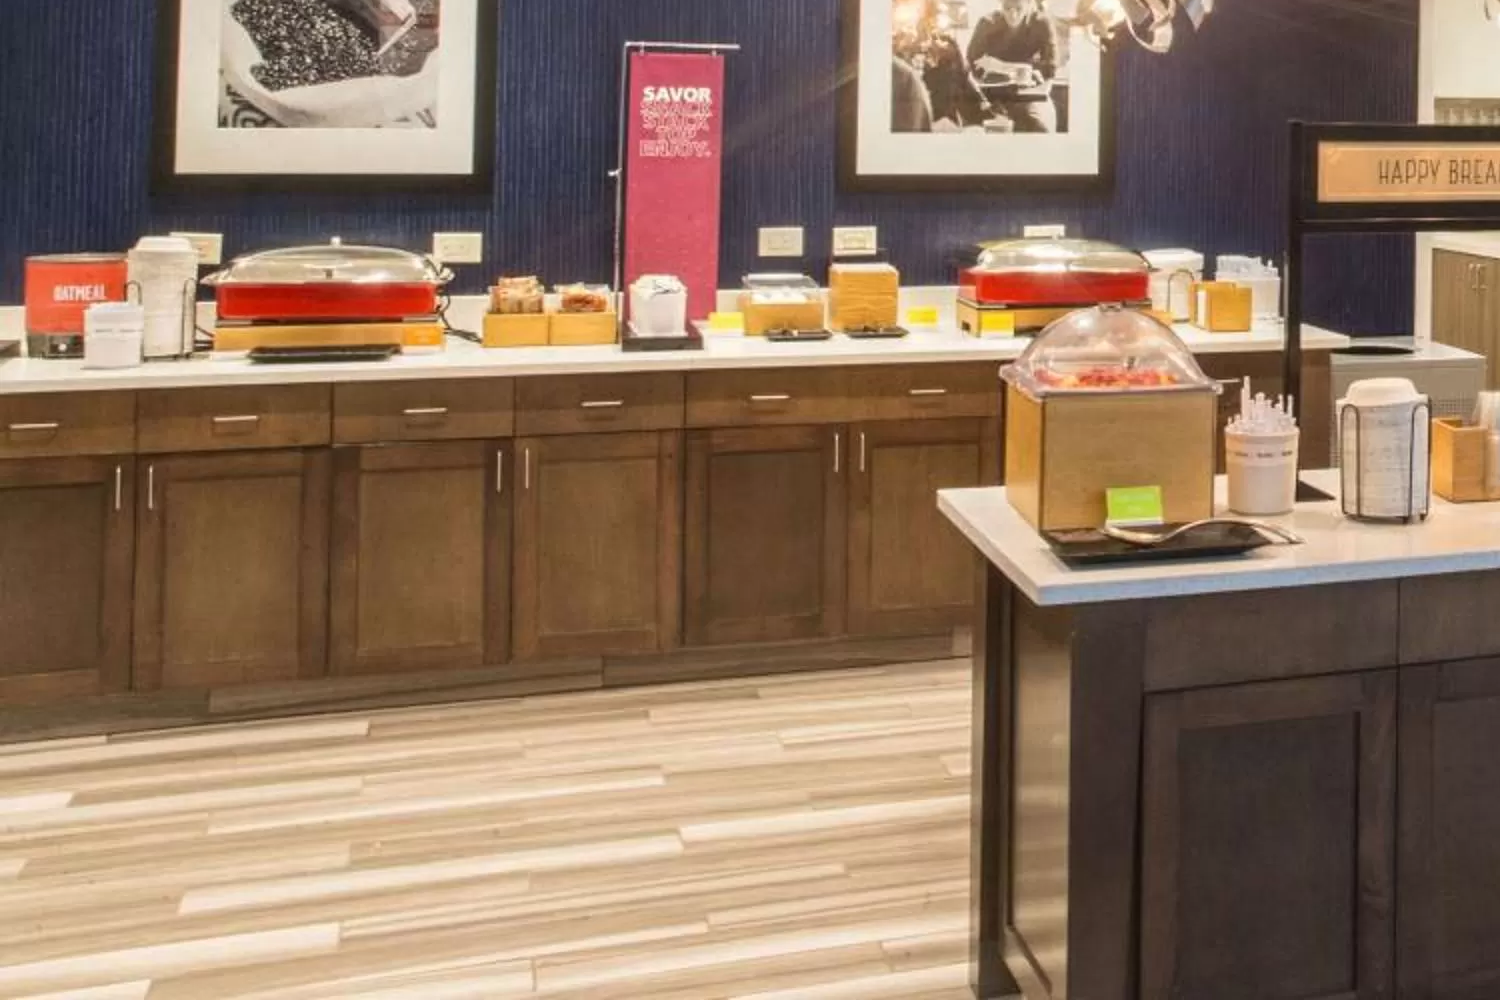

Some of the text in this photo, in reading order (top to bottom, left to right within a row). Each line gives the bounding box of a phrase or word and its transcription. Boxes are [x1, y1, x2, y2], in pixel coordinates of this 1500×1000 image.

[643, 86, 711, 102] SAVOR
[1378, 159, 1440, 185] HAPPY
[53, 284, 106, 301] OATMEAL
